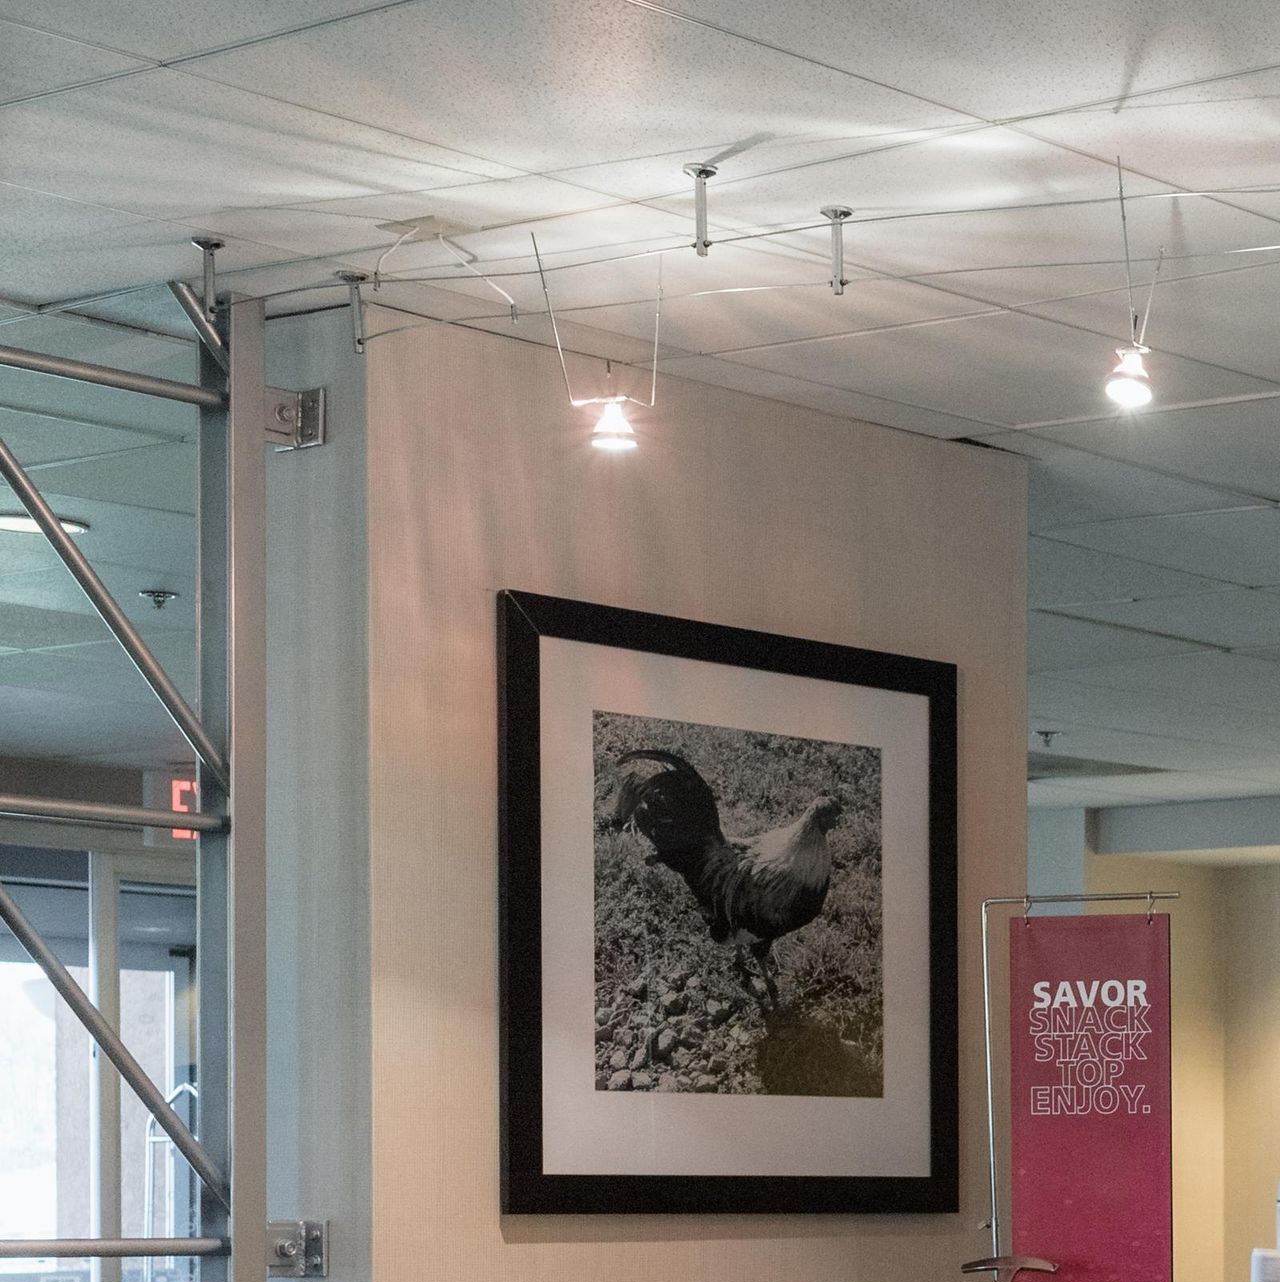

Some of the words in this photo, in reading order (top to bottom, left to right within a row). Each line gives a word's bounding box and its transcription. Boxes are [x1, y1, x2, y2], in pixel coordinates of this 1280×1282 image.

[1033, 980, 1148, 1008] SAVOR
[1029, 1004, 1152, 1035] SNACK
[1034, 1031, 1147, 1061] STACK
[1056, 1059, 1124, 1087] TOP
[1031, 1085, 1151, 1115] ENJOY.
